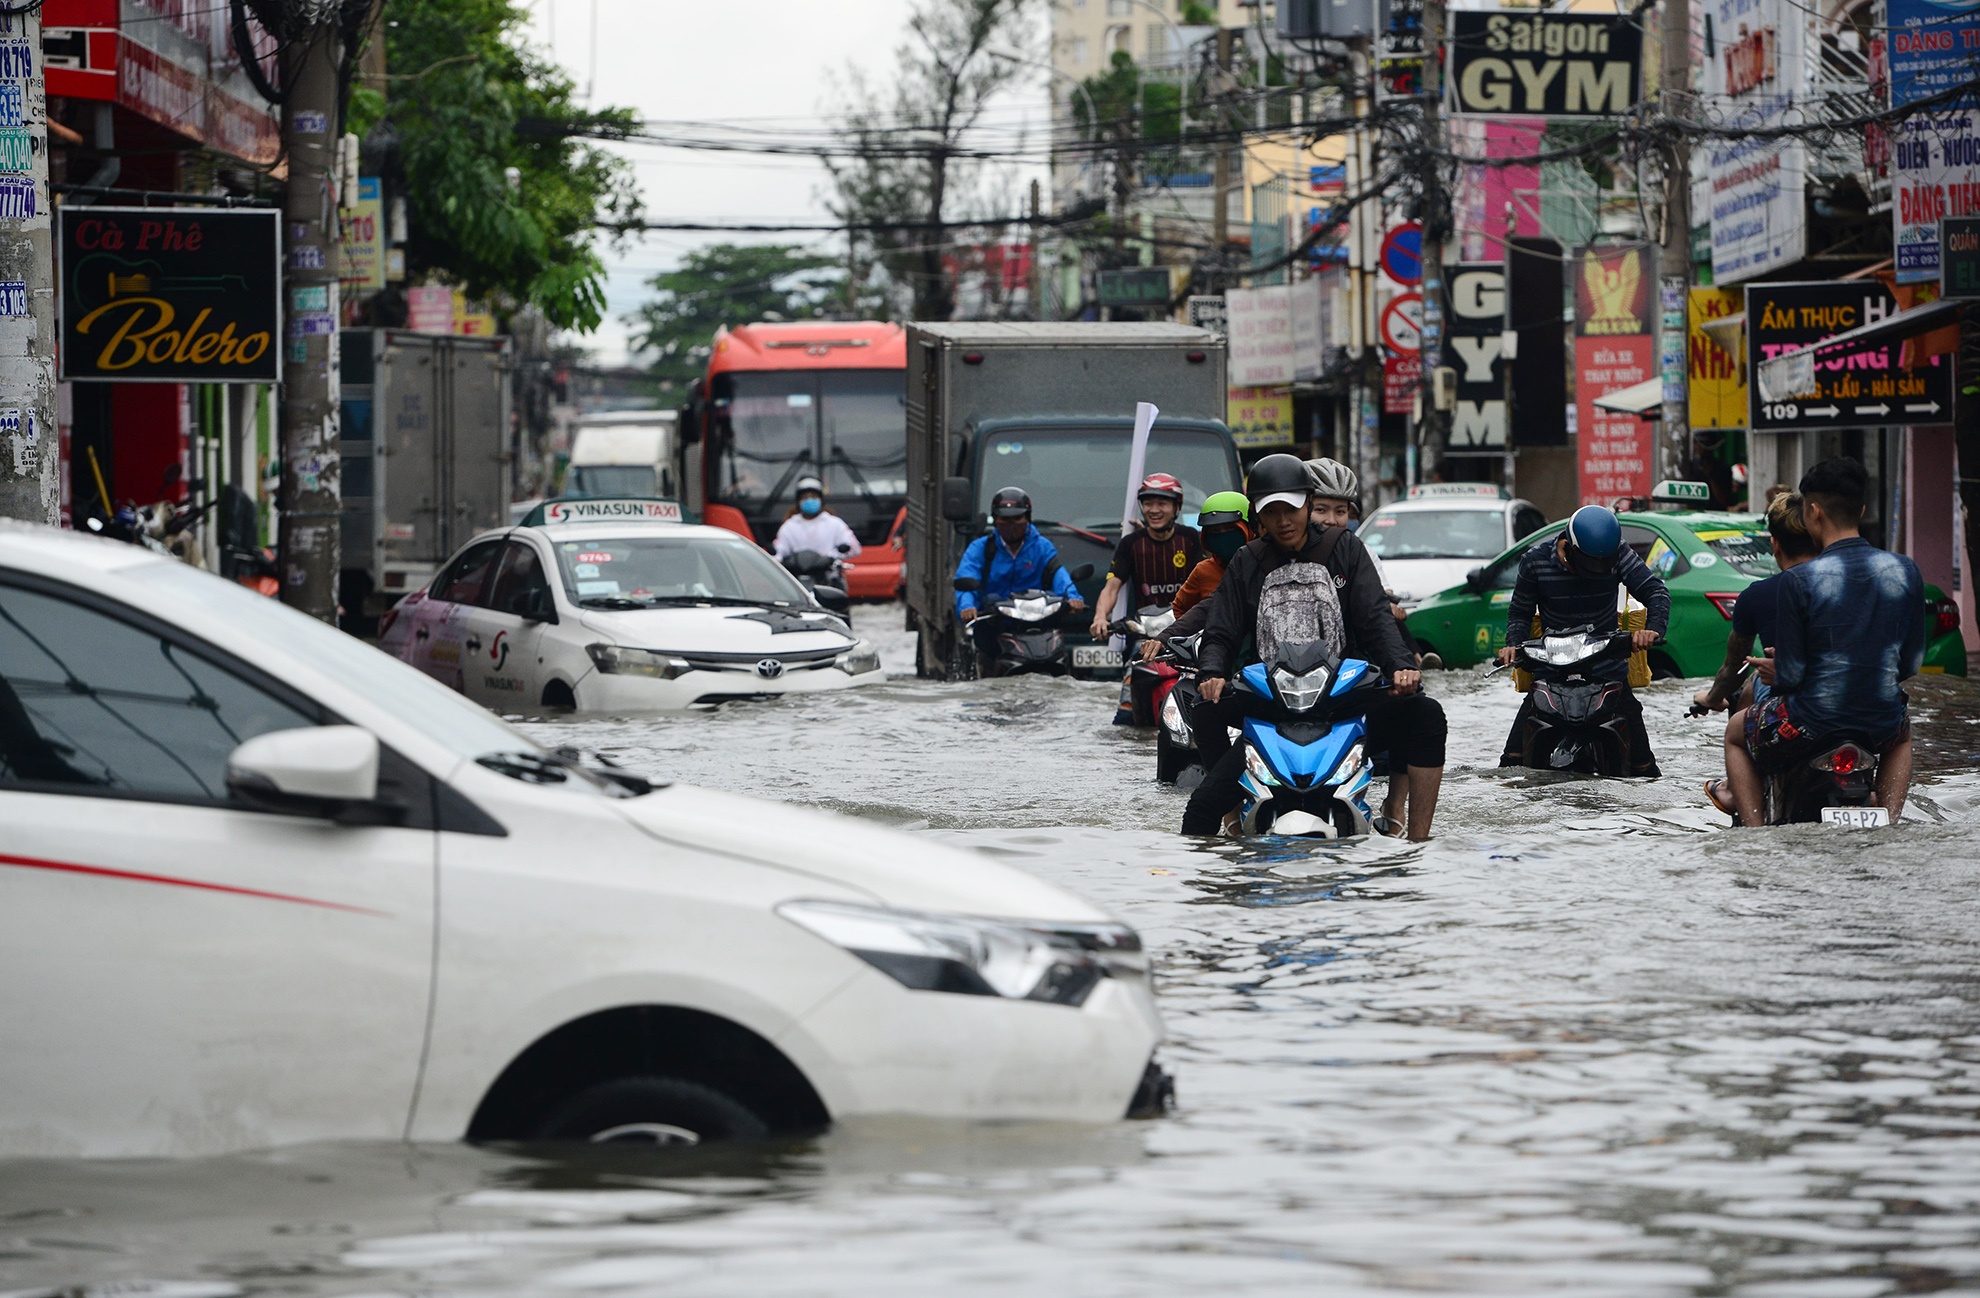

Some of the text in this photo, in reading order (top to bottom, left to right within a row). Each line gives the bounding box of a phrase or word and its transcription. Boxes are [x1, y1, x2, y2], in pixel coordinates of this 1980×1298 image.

[1485, 14, 1610, 56] Saigon
[1961, 29, 1980, 48] TI
[1460, 57, 1632, 113] GYM
[0, 95, 22, 126] 3.55
[76, 220, 203, 251] Cà Phê
[0, 289, 26, 314] 3.103
[1800, 305, 1856, 331] THỰC
[75, 297, 270, 370] Bolero
[1762, 404, 1798, 419] 109
[575, 503, 678, 517] VINASUN TAXI
